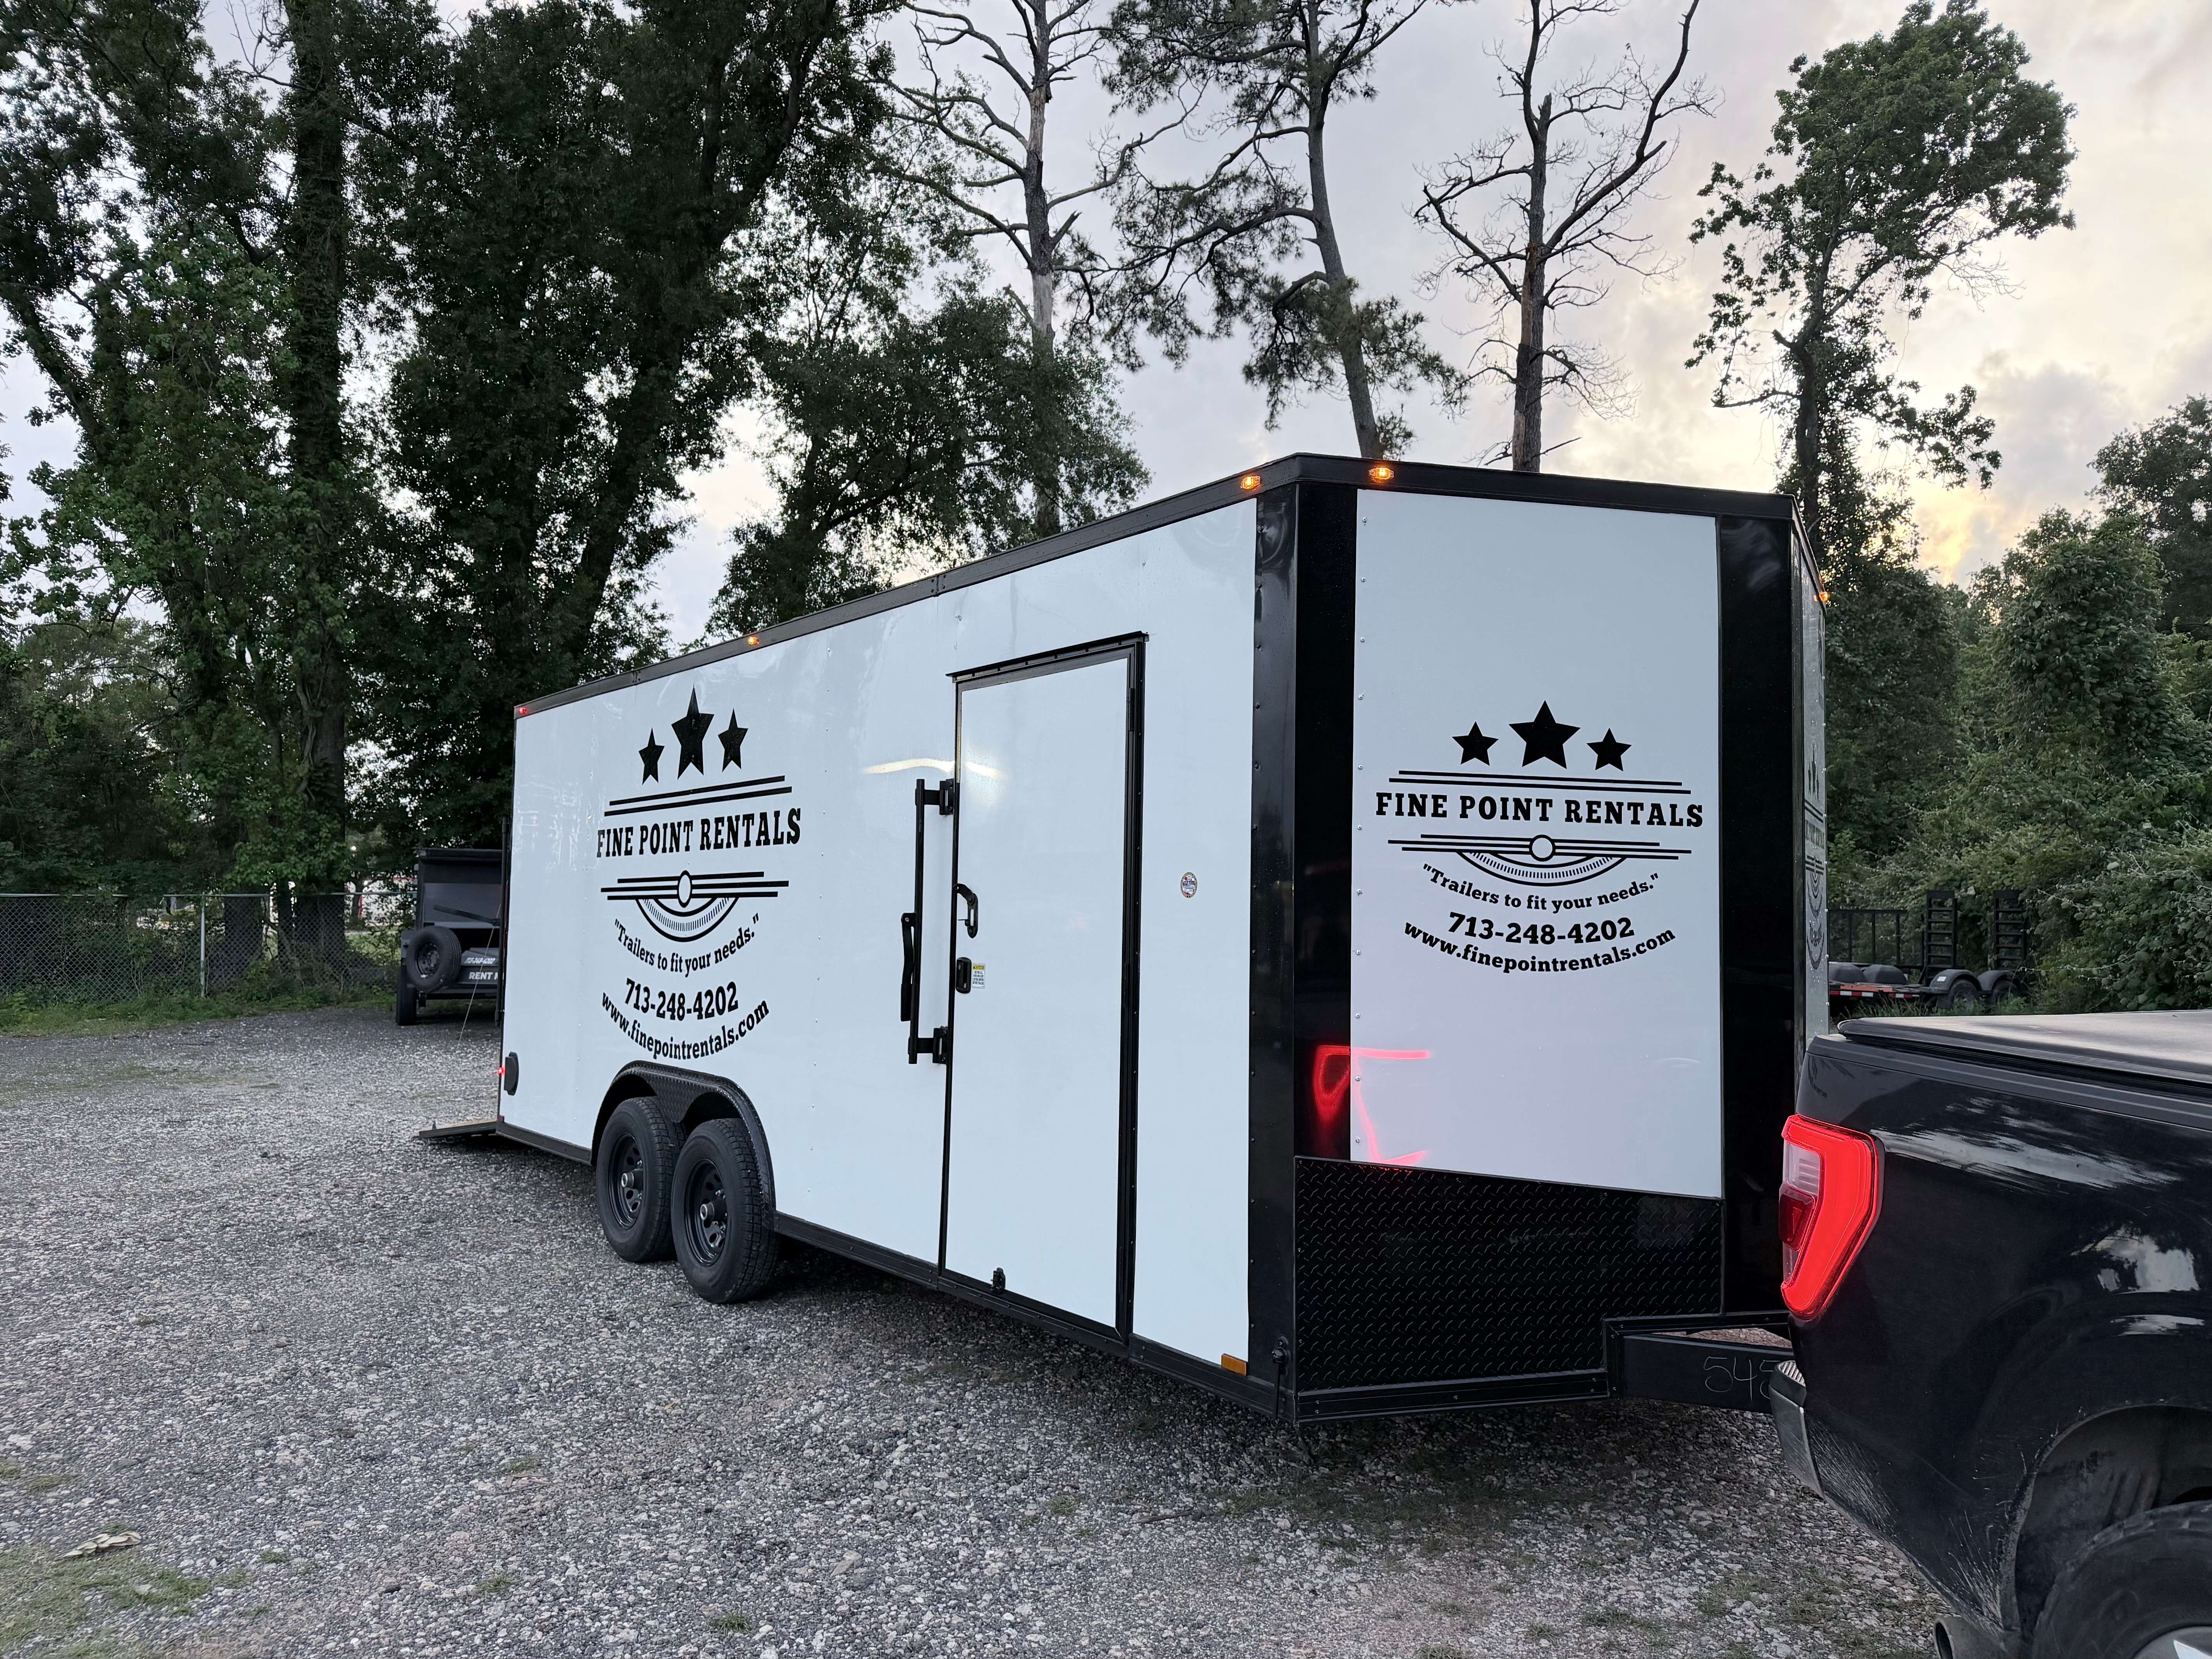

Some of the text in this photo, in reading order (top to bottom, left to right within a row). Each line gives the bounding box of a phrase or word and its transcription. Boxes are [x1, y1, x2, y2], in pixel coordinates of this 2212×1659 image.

[596, 808, 801, 858] FINE POINT RENTALS
[1376, 792, 1703, 828] FINE POINT RENTALS
[1423, 863, 1659, 914] "Trailers to fit your needs."
[615, 912, 759, 978] "Trailers to fit your needs."
[1405, 922, 1676, 974] www.finepointrentals.com
[1448, 912, 1635, 945] 713-248-4202
[469, 972, 493, 980] RENT
[625, 977, 738, 1021] 713-248-4202
[602, 992, 769, 1060] www.finepointrentals.com
